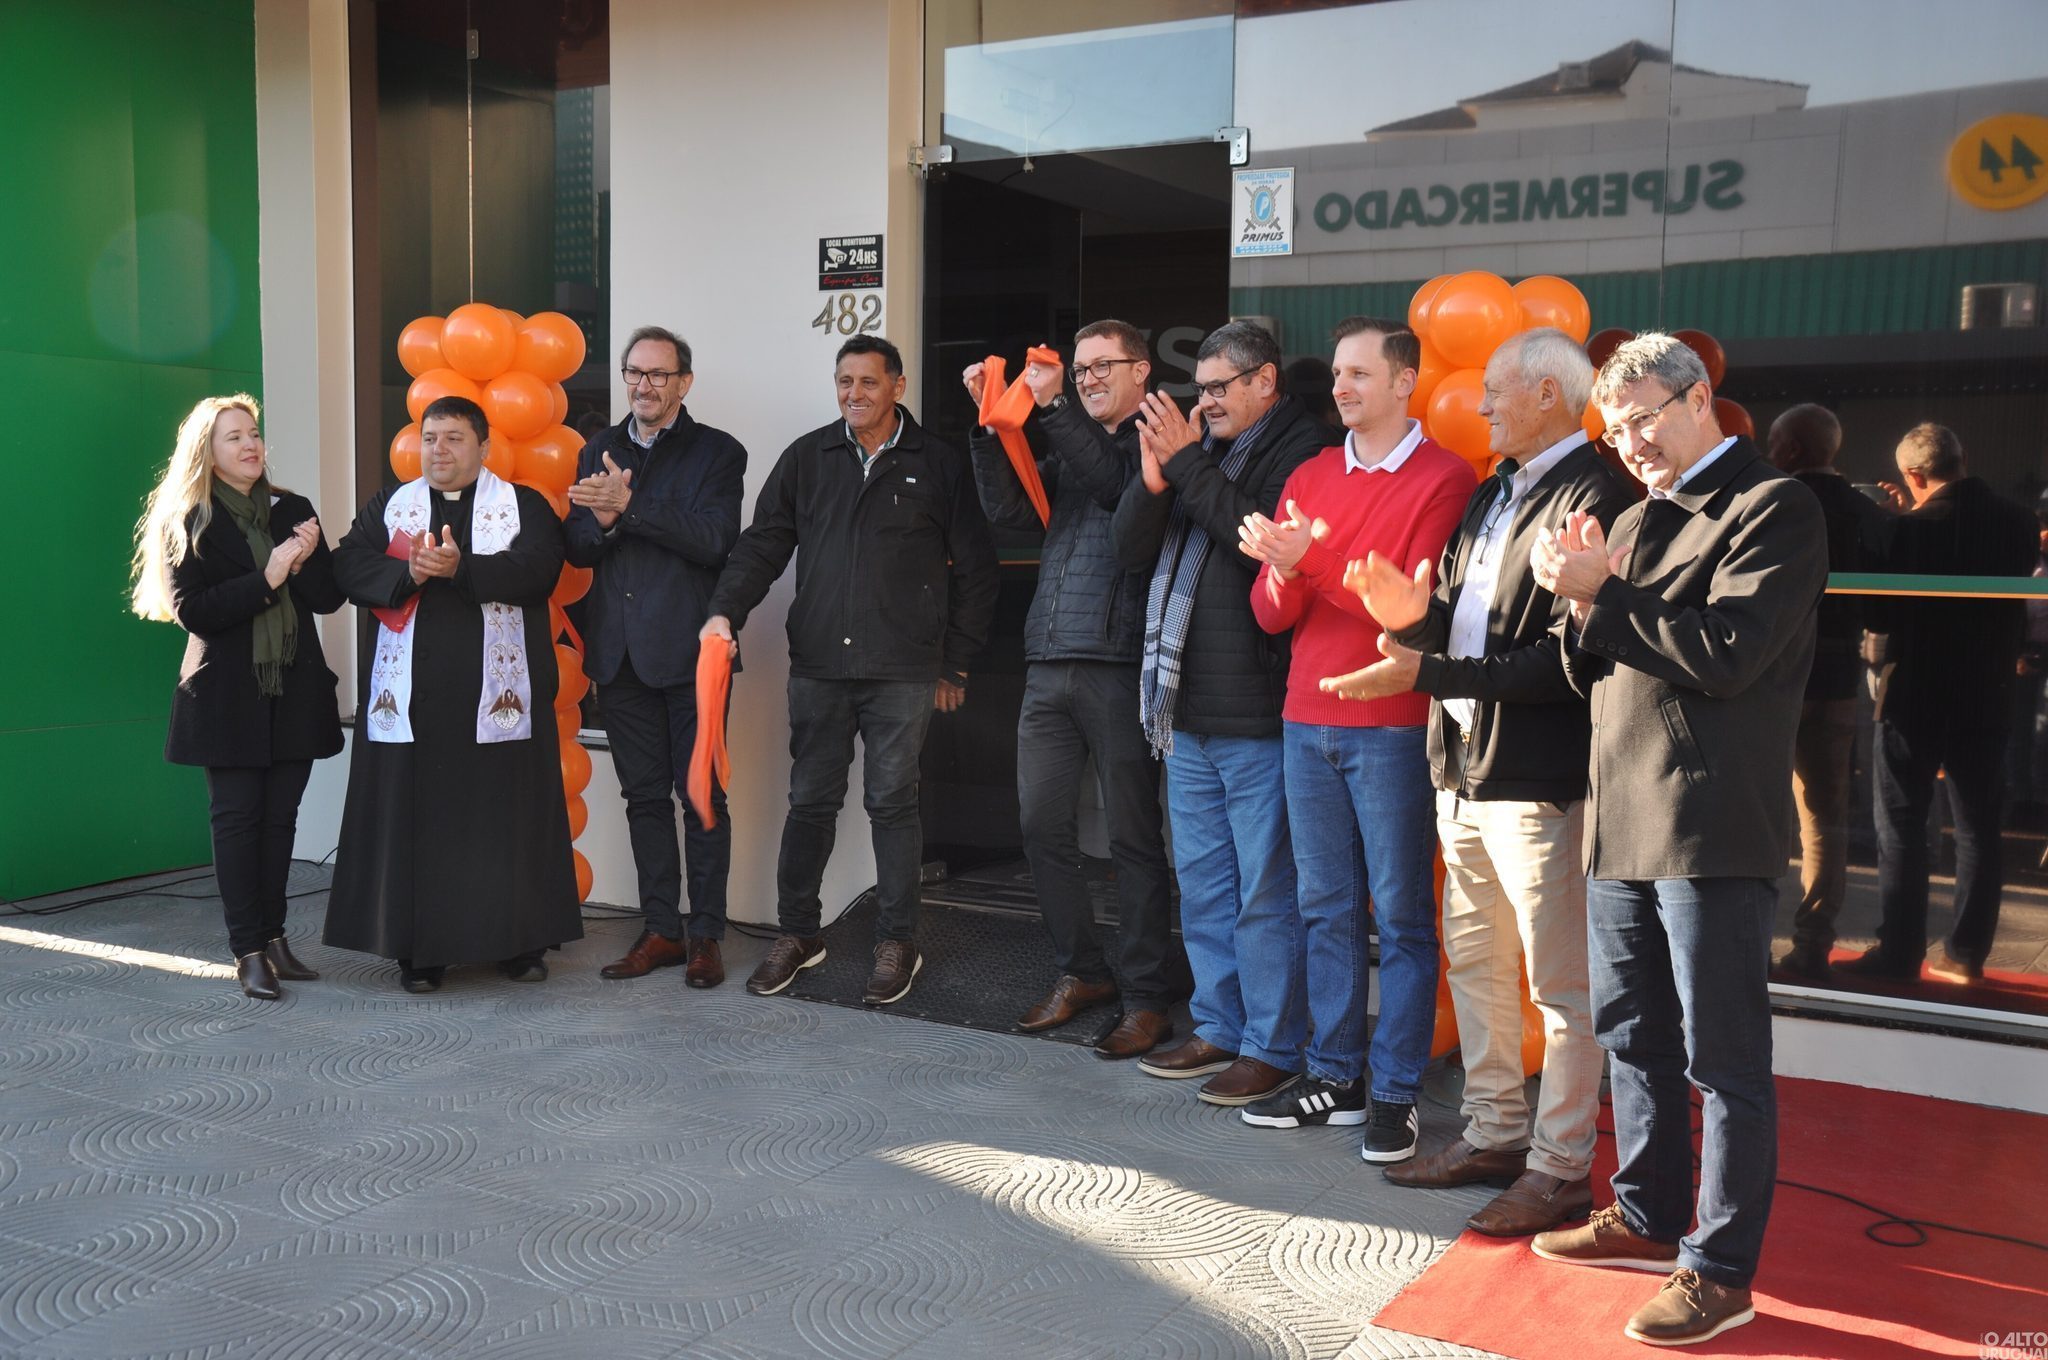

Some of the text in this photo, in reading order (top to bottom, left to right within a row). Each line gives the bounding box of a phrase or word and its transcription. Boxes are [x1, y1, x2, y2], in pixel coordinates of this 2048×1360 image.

[826, 237, 876, 247] LOCAL MONITORADO
[1241, 232, 1284, 242] PRIMUS
[849, 249, 877, 265] 24HS
[812, 292, 882, 335] 482
